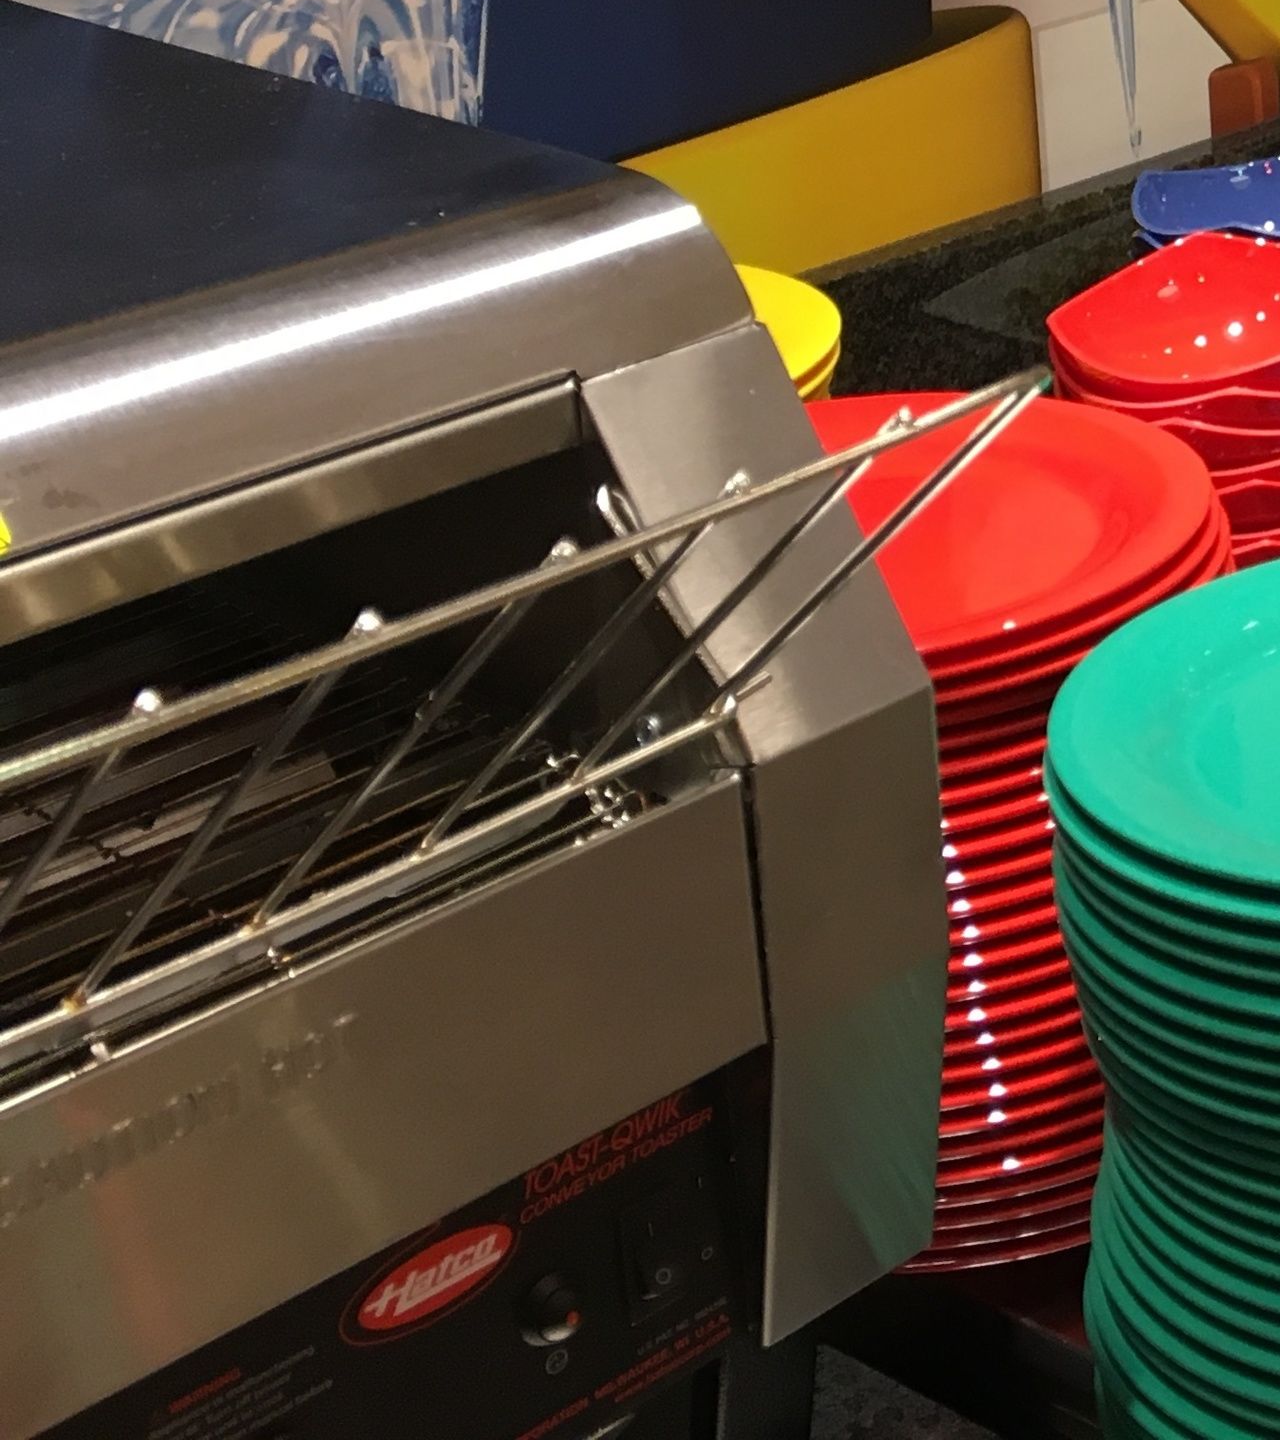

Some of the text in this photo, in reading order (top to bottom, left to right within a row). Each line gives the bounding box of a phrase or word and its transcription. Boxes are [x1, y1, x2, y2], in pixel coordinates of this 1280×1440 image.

[520, 1107, 713, 1224] CONVEYOR TOASTER
[525, 1088, 688, 1200] TOAST-QWIK
[364, 1233, 501, 1317] Hatco
